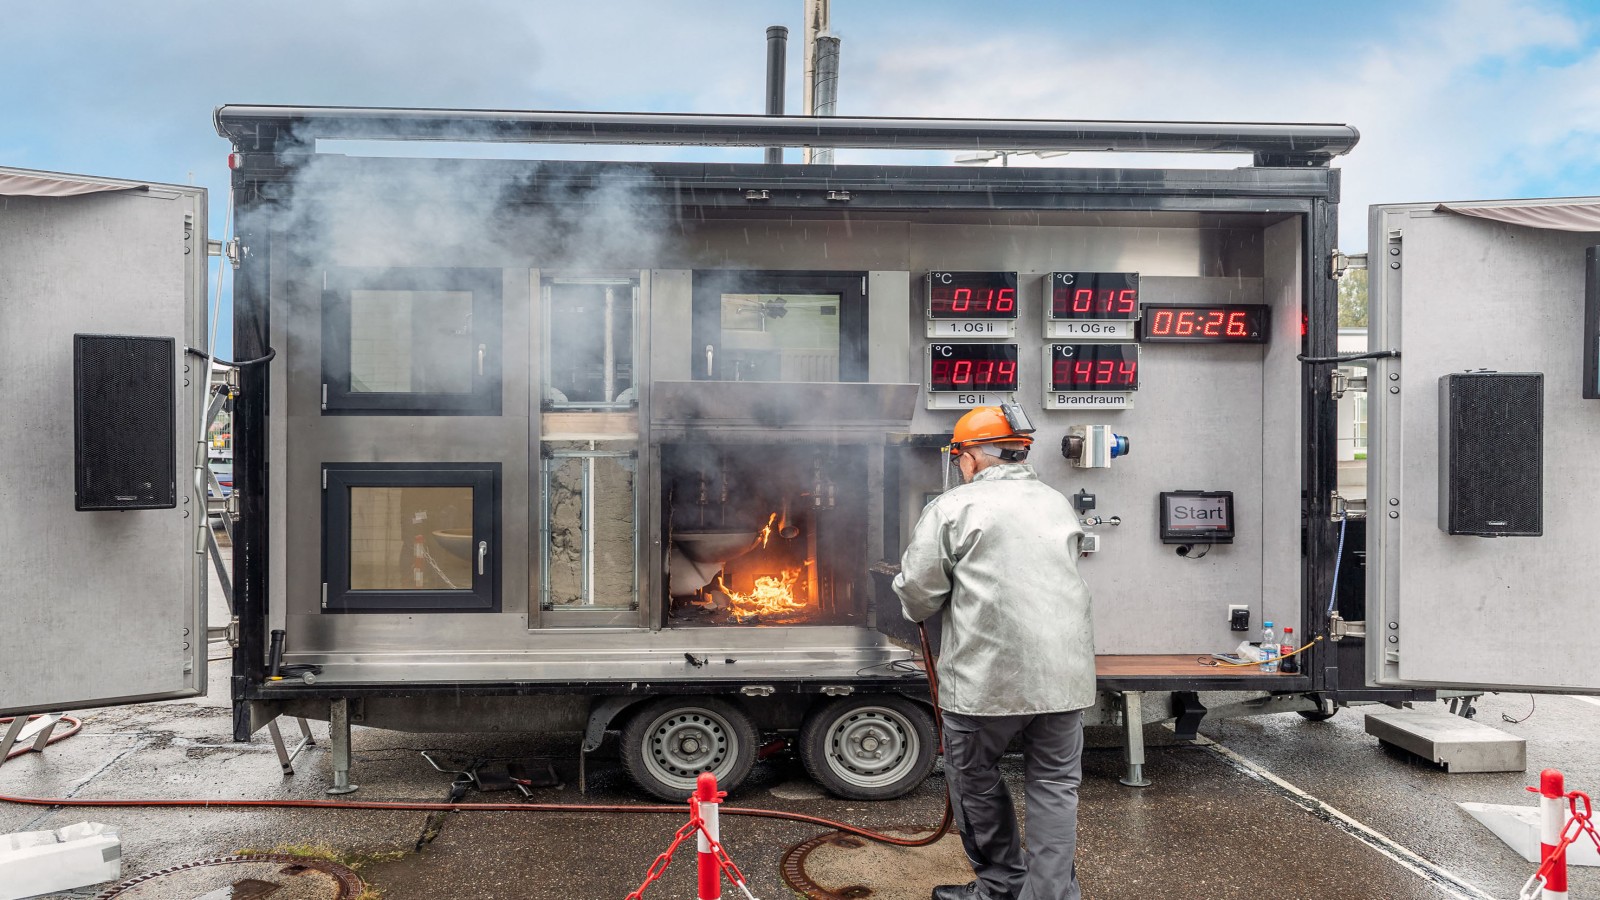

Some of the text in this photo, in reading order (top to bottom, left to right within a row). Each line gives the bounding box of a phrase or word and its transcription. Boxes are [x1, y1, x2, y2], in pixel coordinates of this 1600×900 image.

[935, 273, 953, 284] °C
[1056, 273, 1074, 285] °C
[952, 288, 1015, 311] 016
[1073, 289, 1136, 312] 015
[950, 322, 993, 332] 1. OG li
[1067, 323, 1116, 333] 1. OG re
[935, 345, 953, 357] °C
[1056, 345, 1074, 357] °C
[952, 360, 1016, 384] 014
[1074, 360, 1137, 384] 434
[958, 394, 985, 404] EG li
[1057, 394, 1125, 404] Brandraum
[1173, 505, 1224, 520] Start
